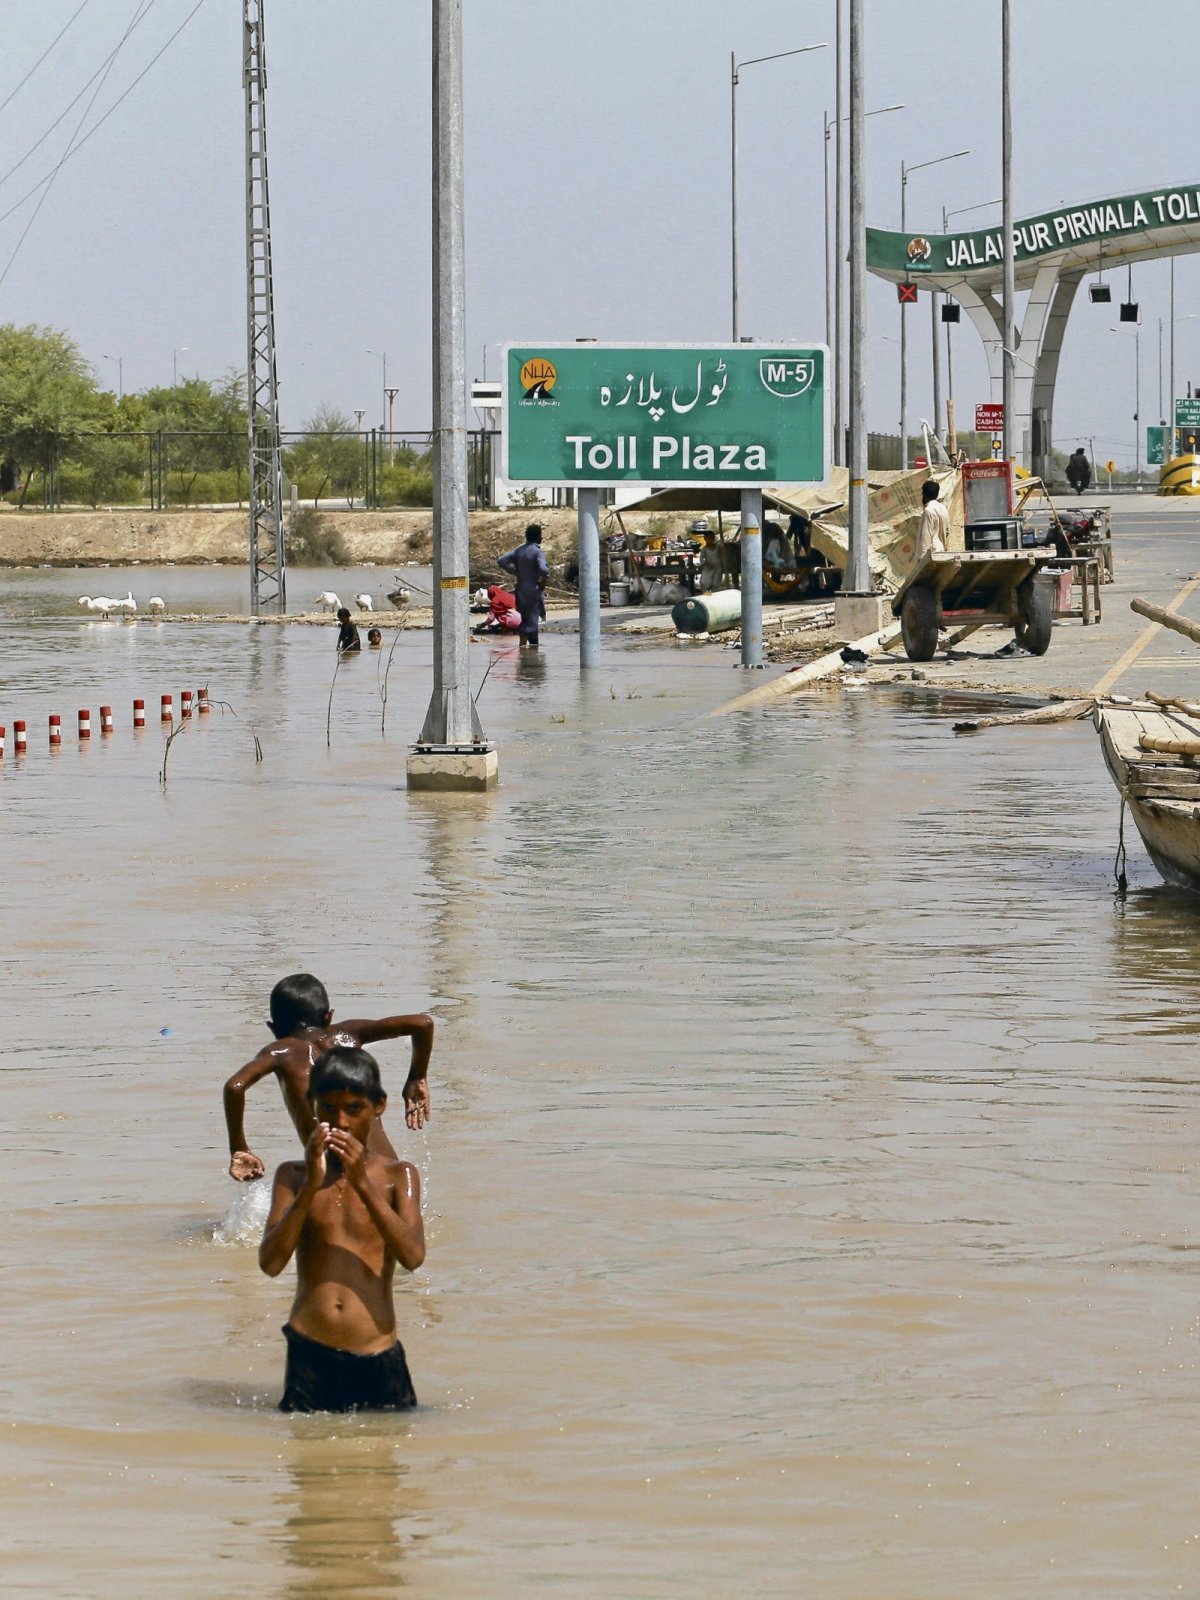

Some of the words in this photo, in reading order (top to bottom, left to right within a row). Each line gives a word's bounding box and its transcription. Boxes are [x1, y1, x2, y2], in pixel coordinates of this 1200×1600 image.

[1053, 200, 1149, 243] PIRWALA
[523, 362, 556, 379] NHA
[671, 356, 728, 414] ٹول
[767, 363, 808, 382] M-5
[600, 371, 665, 422] پلازہ
[565, 435, 637, 470] Toll
[652, 436, 767, 470] Plaza
